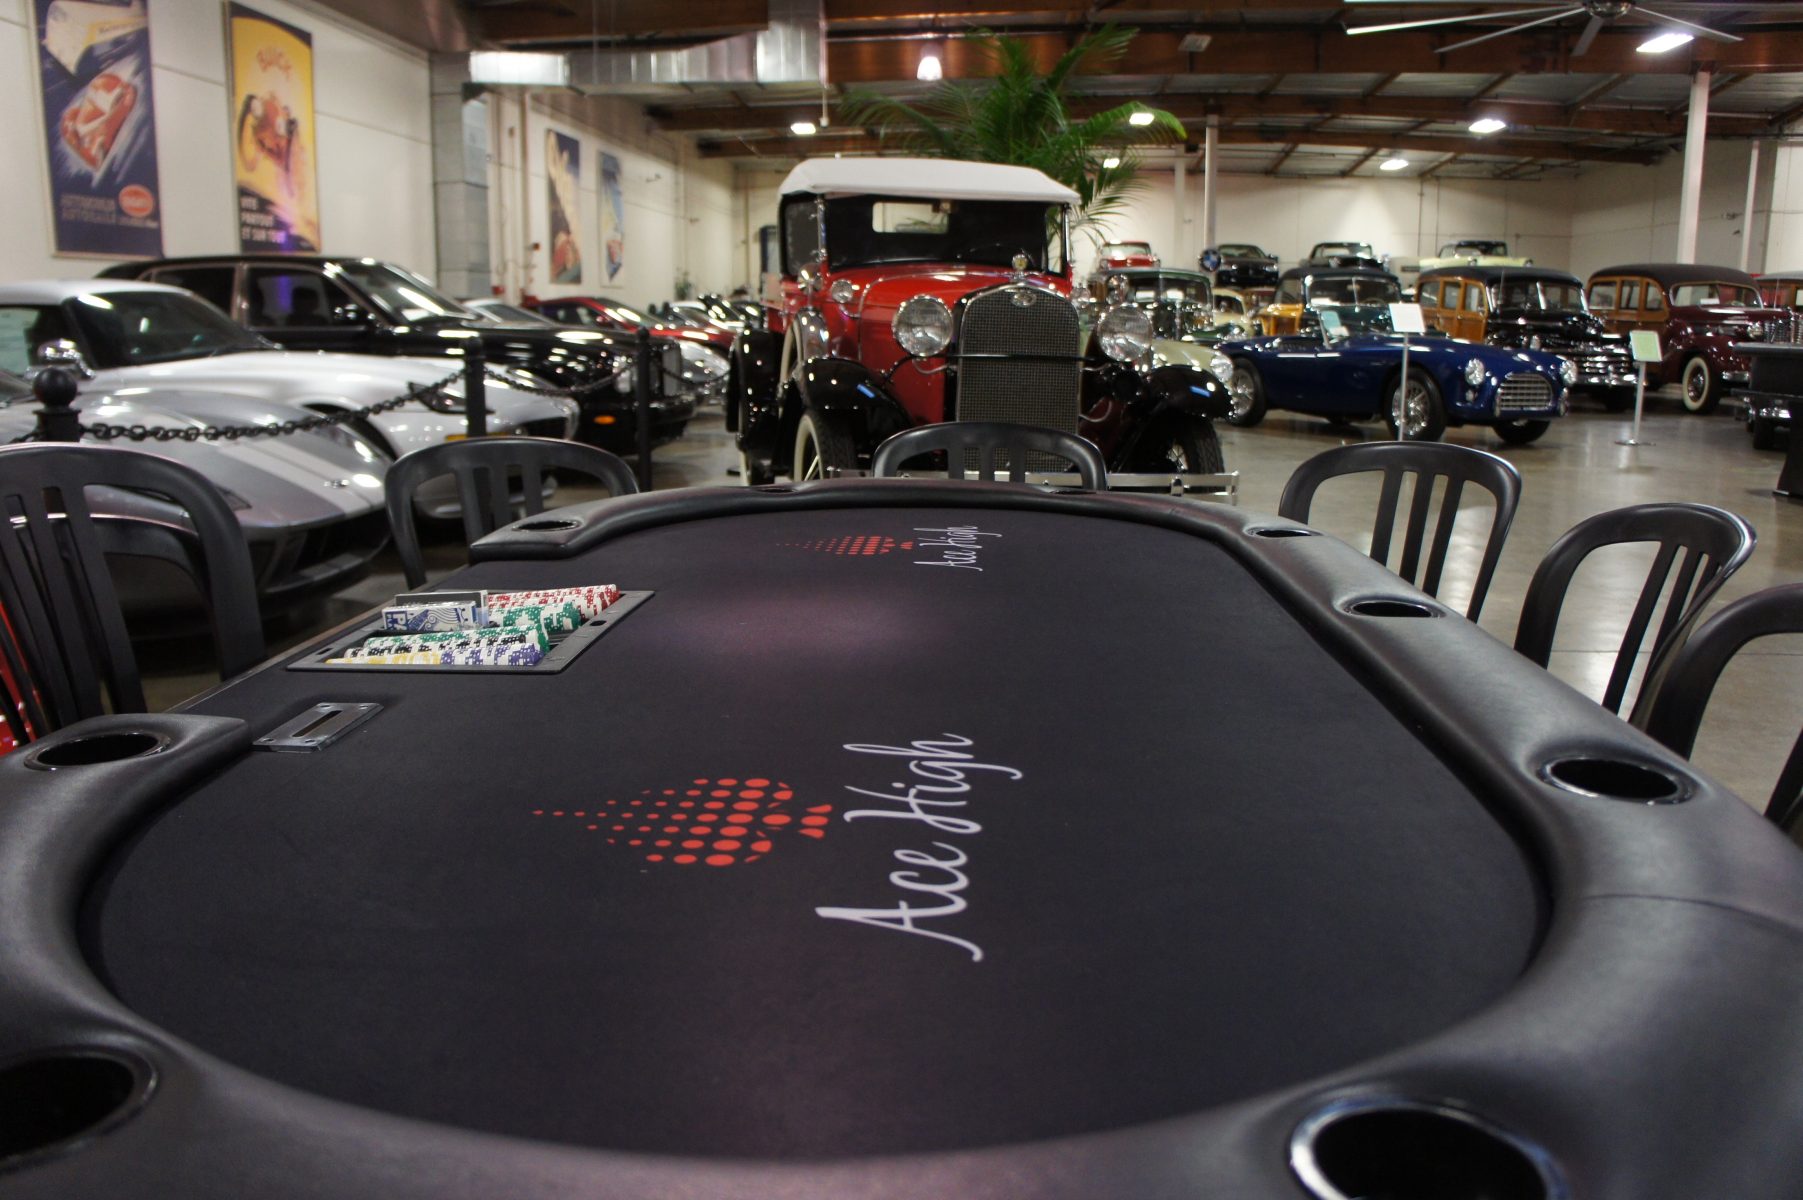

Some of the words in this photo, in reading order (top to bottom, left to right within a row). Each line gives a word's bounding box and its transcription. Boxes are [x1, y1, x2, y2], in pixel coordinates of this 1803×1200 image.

[913, 525, 1002, 549] High
[913, 549, 983, 571] Ace
[843, 732, 1023, 834] High
[814, 841, 983, 962] Ace
